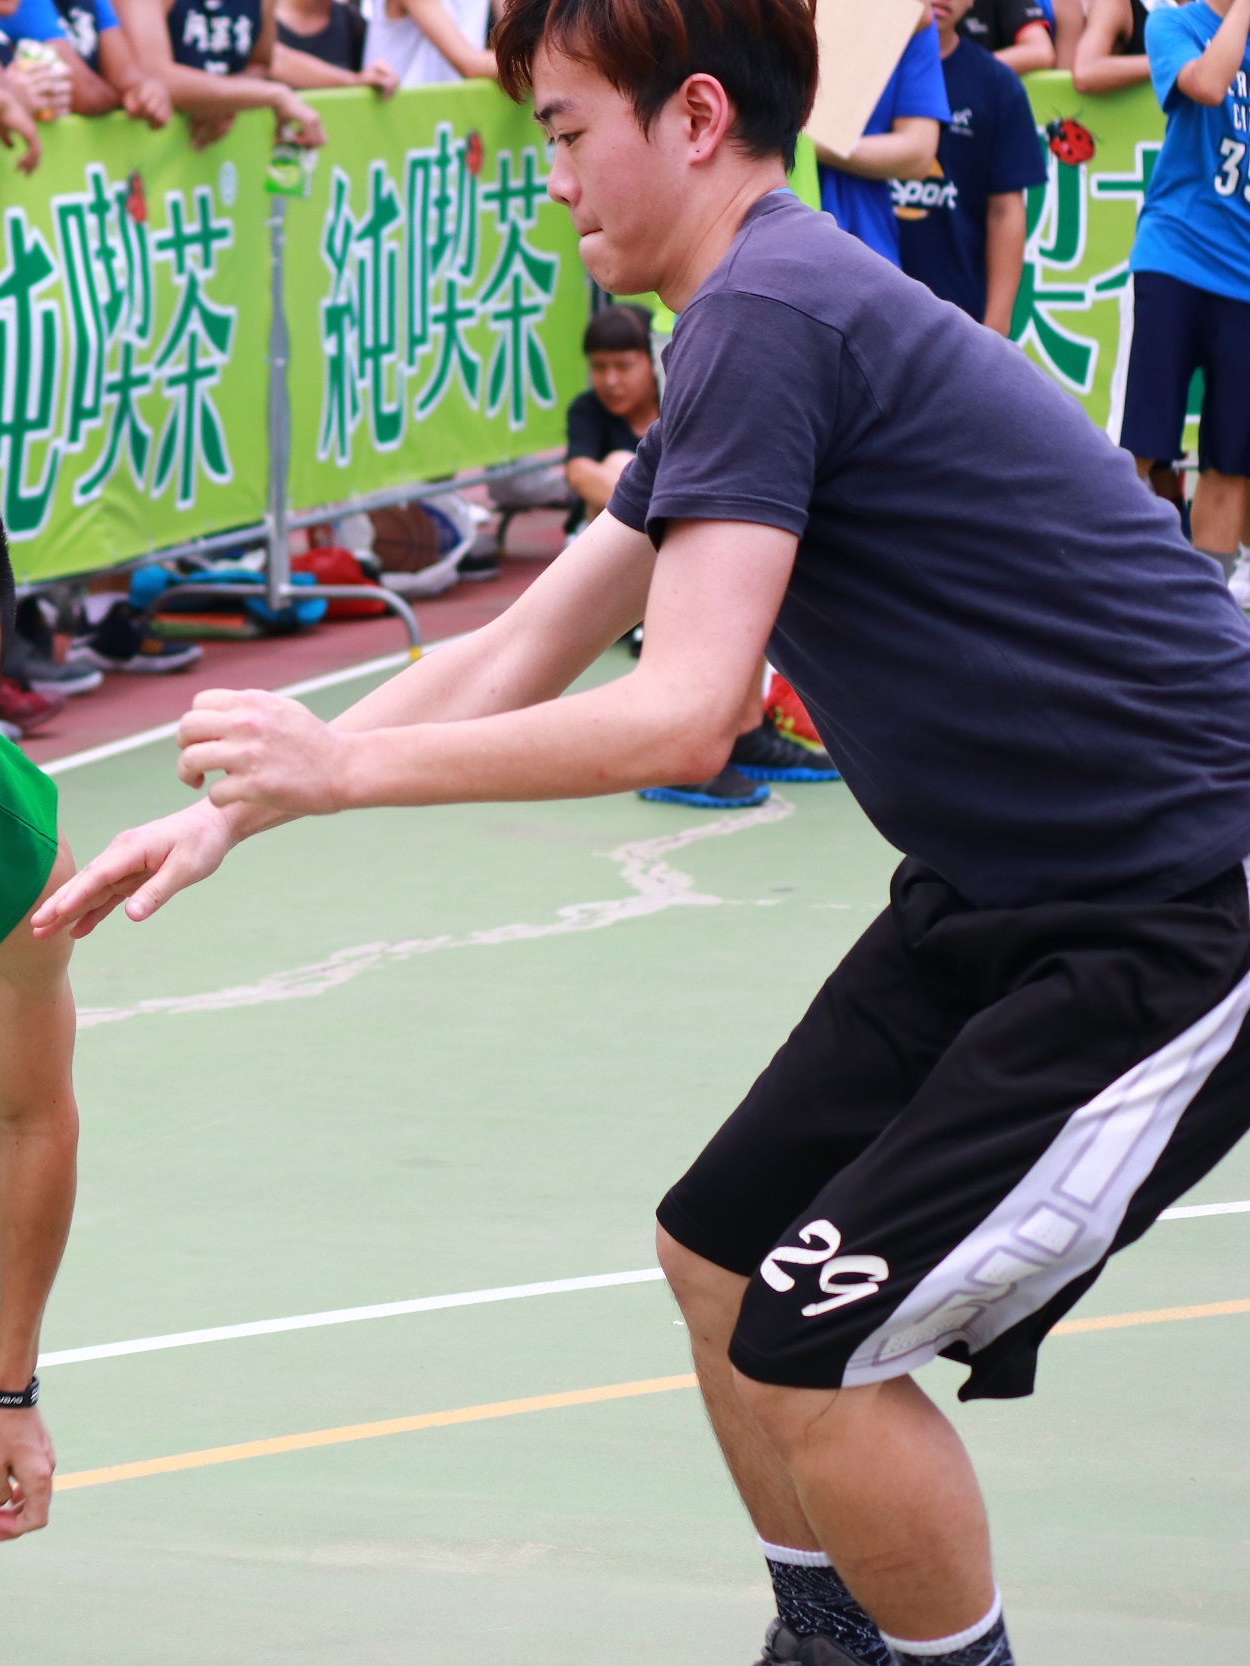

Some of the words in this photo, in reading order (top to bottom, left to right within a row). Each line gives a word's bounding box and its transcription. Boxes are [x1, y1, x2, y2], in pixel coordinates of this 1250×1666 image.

[1214, 137, 1250, 202] 3
[318, 124, 558, 465] 純喫茶
[760, 1219, 889, 1317] 29
